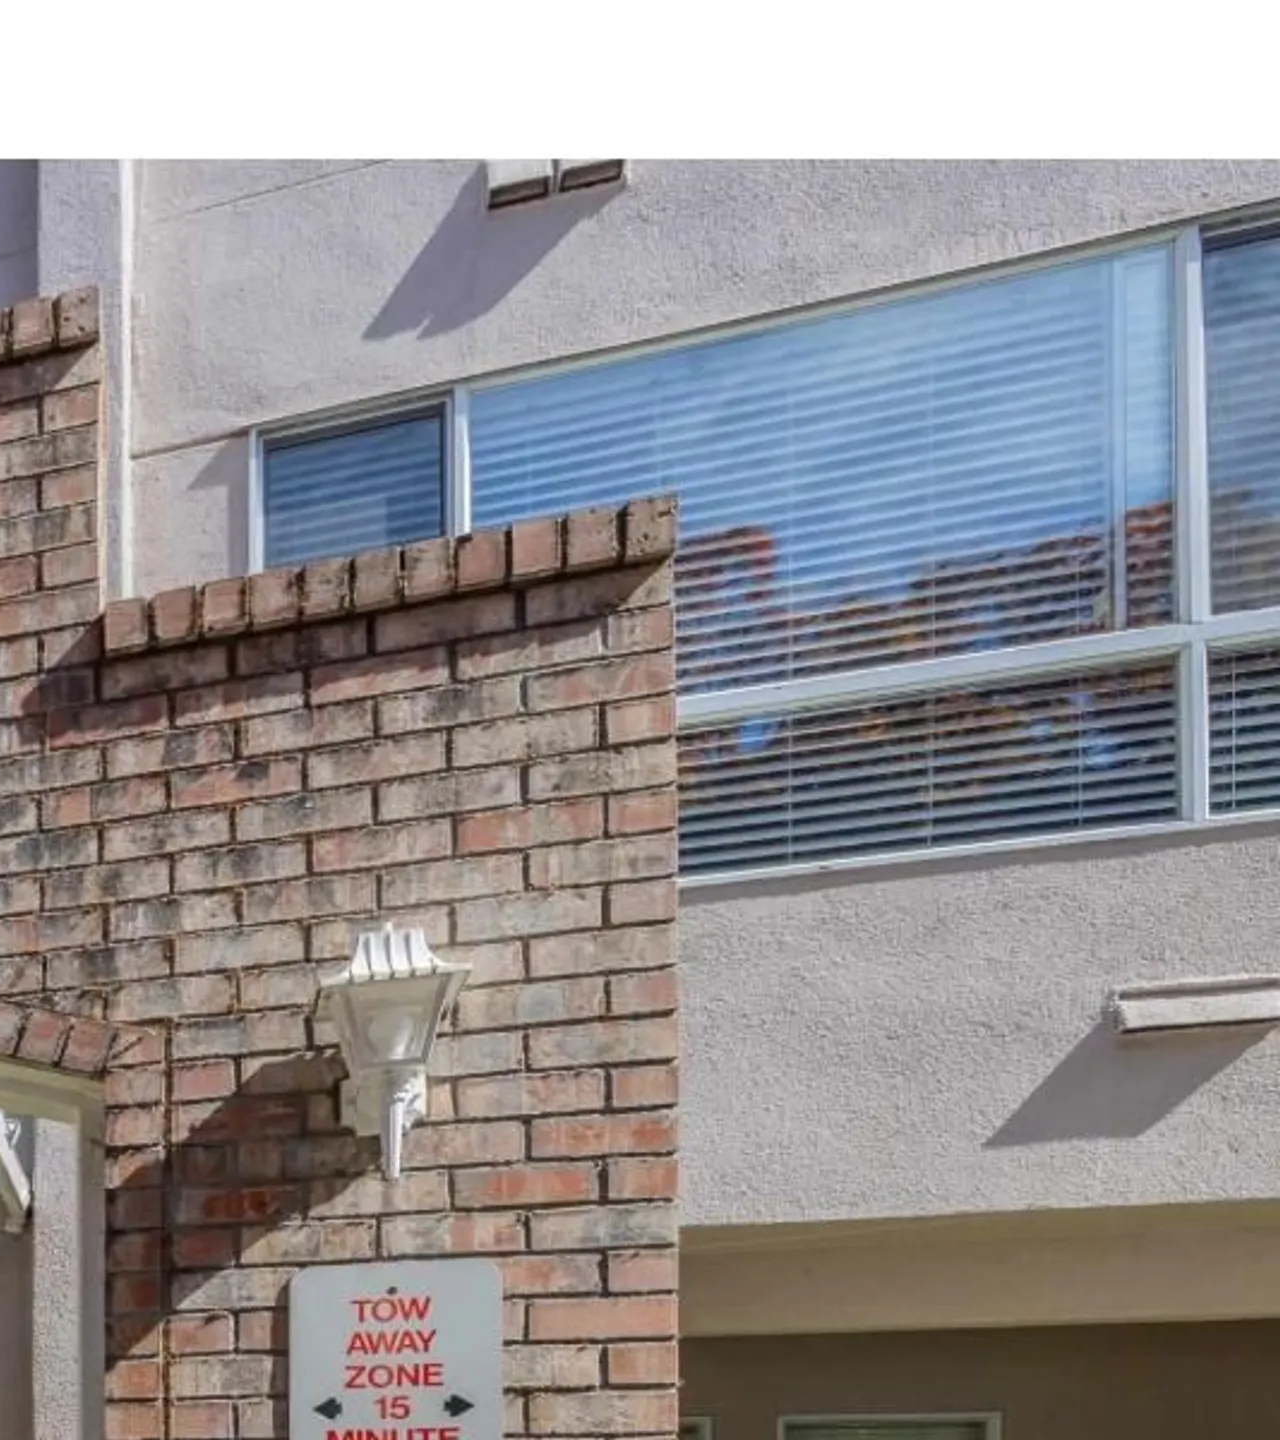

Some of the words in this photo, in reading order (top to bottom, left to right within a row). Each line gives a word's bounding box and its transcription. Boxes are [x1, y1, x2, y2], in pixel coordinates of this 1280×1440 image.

[351, 1296, 431, 1323] TOW
[346, 1329, 436, 1355] AWAY
[344, 1362, 445, 1389] ZONE
[373, 1395, 411, 1420] 15
